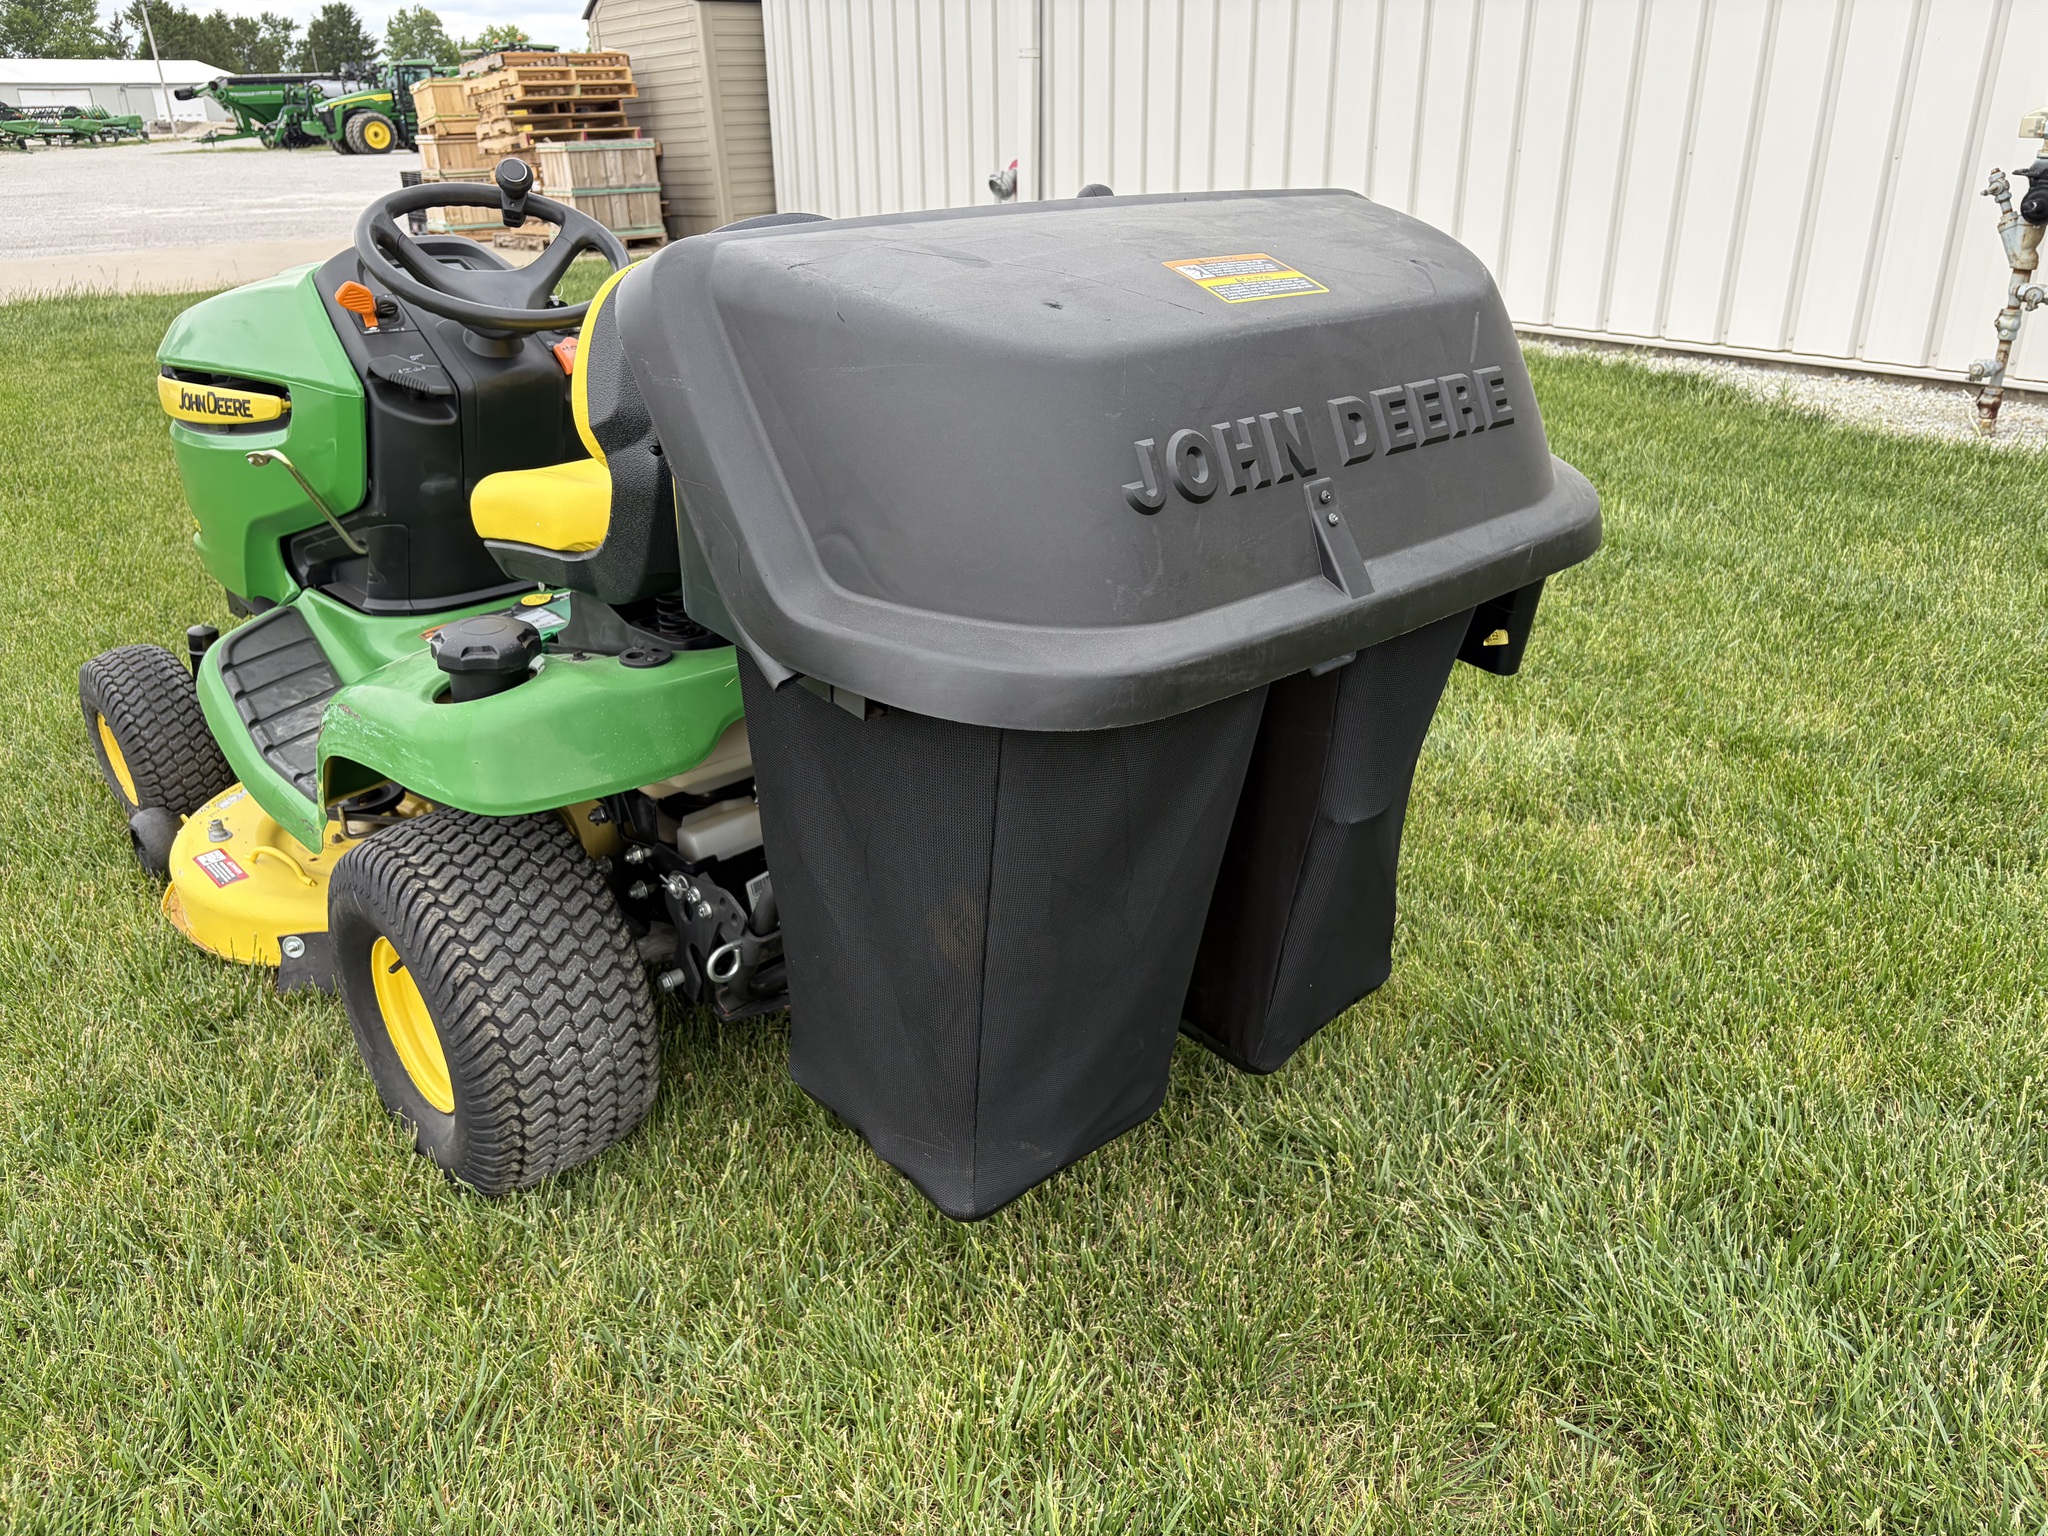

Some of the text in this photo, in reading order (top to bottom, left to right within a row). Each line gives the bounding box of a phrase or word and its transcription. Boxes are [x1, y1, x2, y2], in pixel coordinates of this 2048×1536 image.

[179, 388, 254, 418] JOHN DEERE
[1122, 365, 1515, 515] JOHN DEERE
